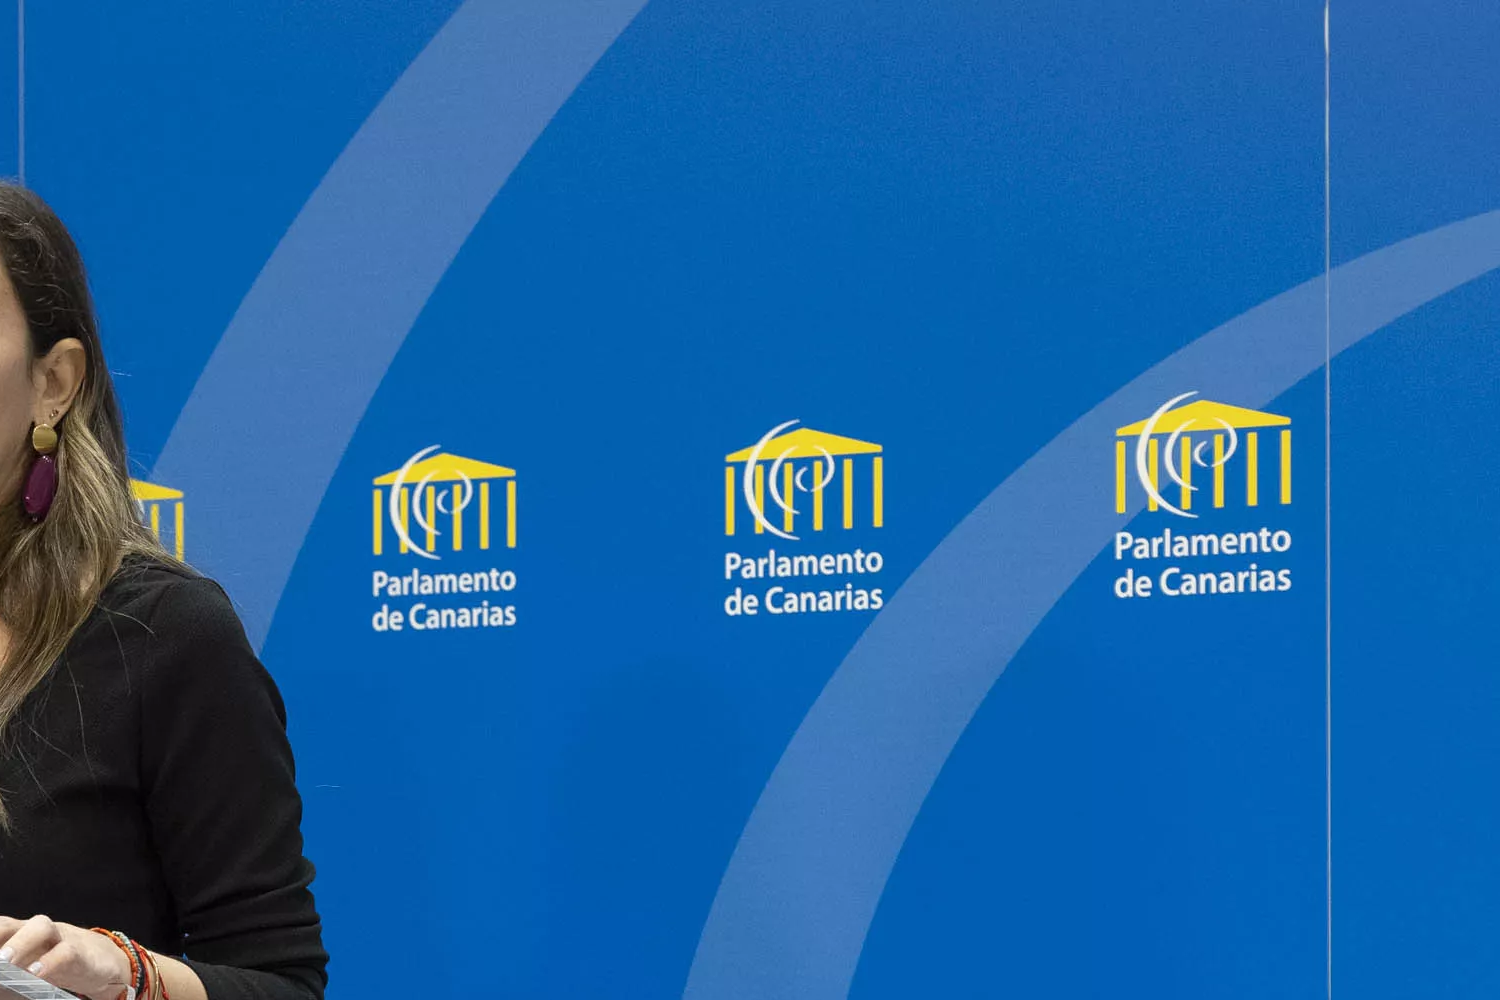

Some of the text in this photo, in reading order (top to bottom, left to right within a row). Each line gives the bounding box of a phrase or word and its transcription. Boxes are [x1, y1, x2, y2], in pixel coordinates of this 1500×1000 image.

[1114, 527, 1292, 560] Parlamento
[724, 548, 884, 580] Parlamento
[372, 567, 517, 597] Parlamento
[1114, 563, 1292, 598] de Canarias
[724, 583, 884, 616] de Canarias
[371, 600, 517, 632] de Canarias
